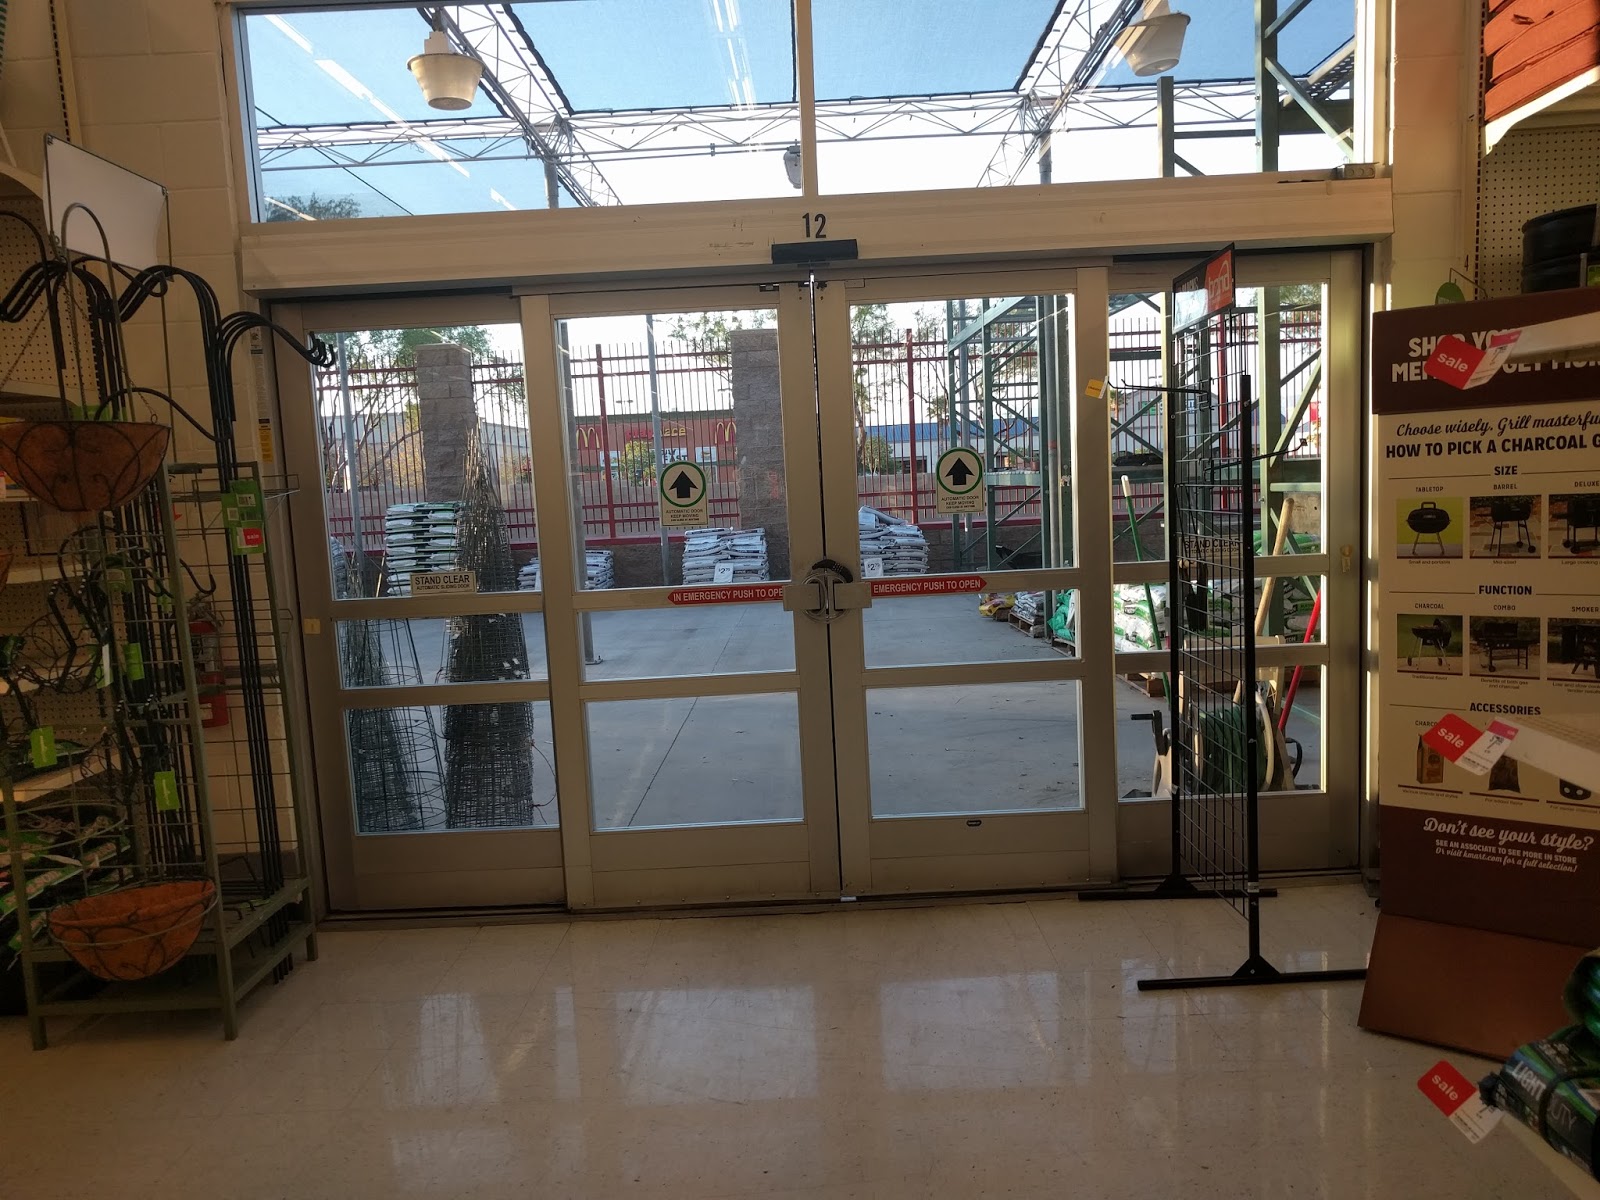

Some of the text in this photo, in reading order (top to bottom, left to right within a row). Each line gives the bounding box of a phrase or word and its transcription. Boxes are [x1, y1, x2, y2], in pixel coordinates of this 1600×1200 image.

[801, 212, 827, 239] 12
[1436, 353, 1469, 373] sale
[1396, 410, 1600, 437] Choose wisely. Grill masterfu
[1386, 443, 1421, 459] HOW
[1425, 442, 1443, 457] TO
[1447, 440, 1482, 456] PICK
[1486, 439, 1497, 454] A
[1501, 434, 1588, 453] CHARCOAL
[1494, 465, 1518, 476] SIZE
[1415, 485, 1444, 493] TABLETOP
[1574, 480, 1600, 488] DELUXE
[414, 574, 470, 585] STAND CLEAR
[873, 579, 981, 594] EMERGENCY PUSH TO OPEN
[673, 588, 783, 602] IN EMERGENCY PUSH TO OPE
[1478, 585, 1533, 596] FUNCTION
[1469, 702, 1541, 716] ACCESSORIES
[1437, 726, 1465, 749] sale
[1423, 817, 1594, 853] Don't see your style?
[1435, 839, 1577, 864] SEE AN ASSOCIATE TO SEE MORE IN STORE
[1502, 855, 1515, 866] for
[1522, 858, 1539, 869] full
[1538, 861, 1578, 873] selection!
[1431, 1073, 1459, 1101] sale
[1548, 1099, 1577, 1131] UTY
